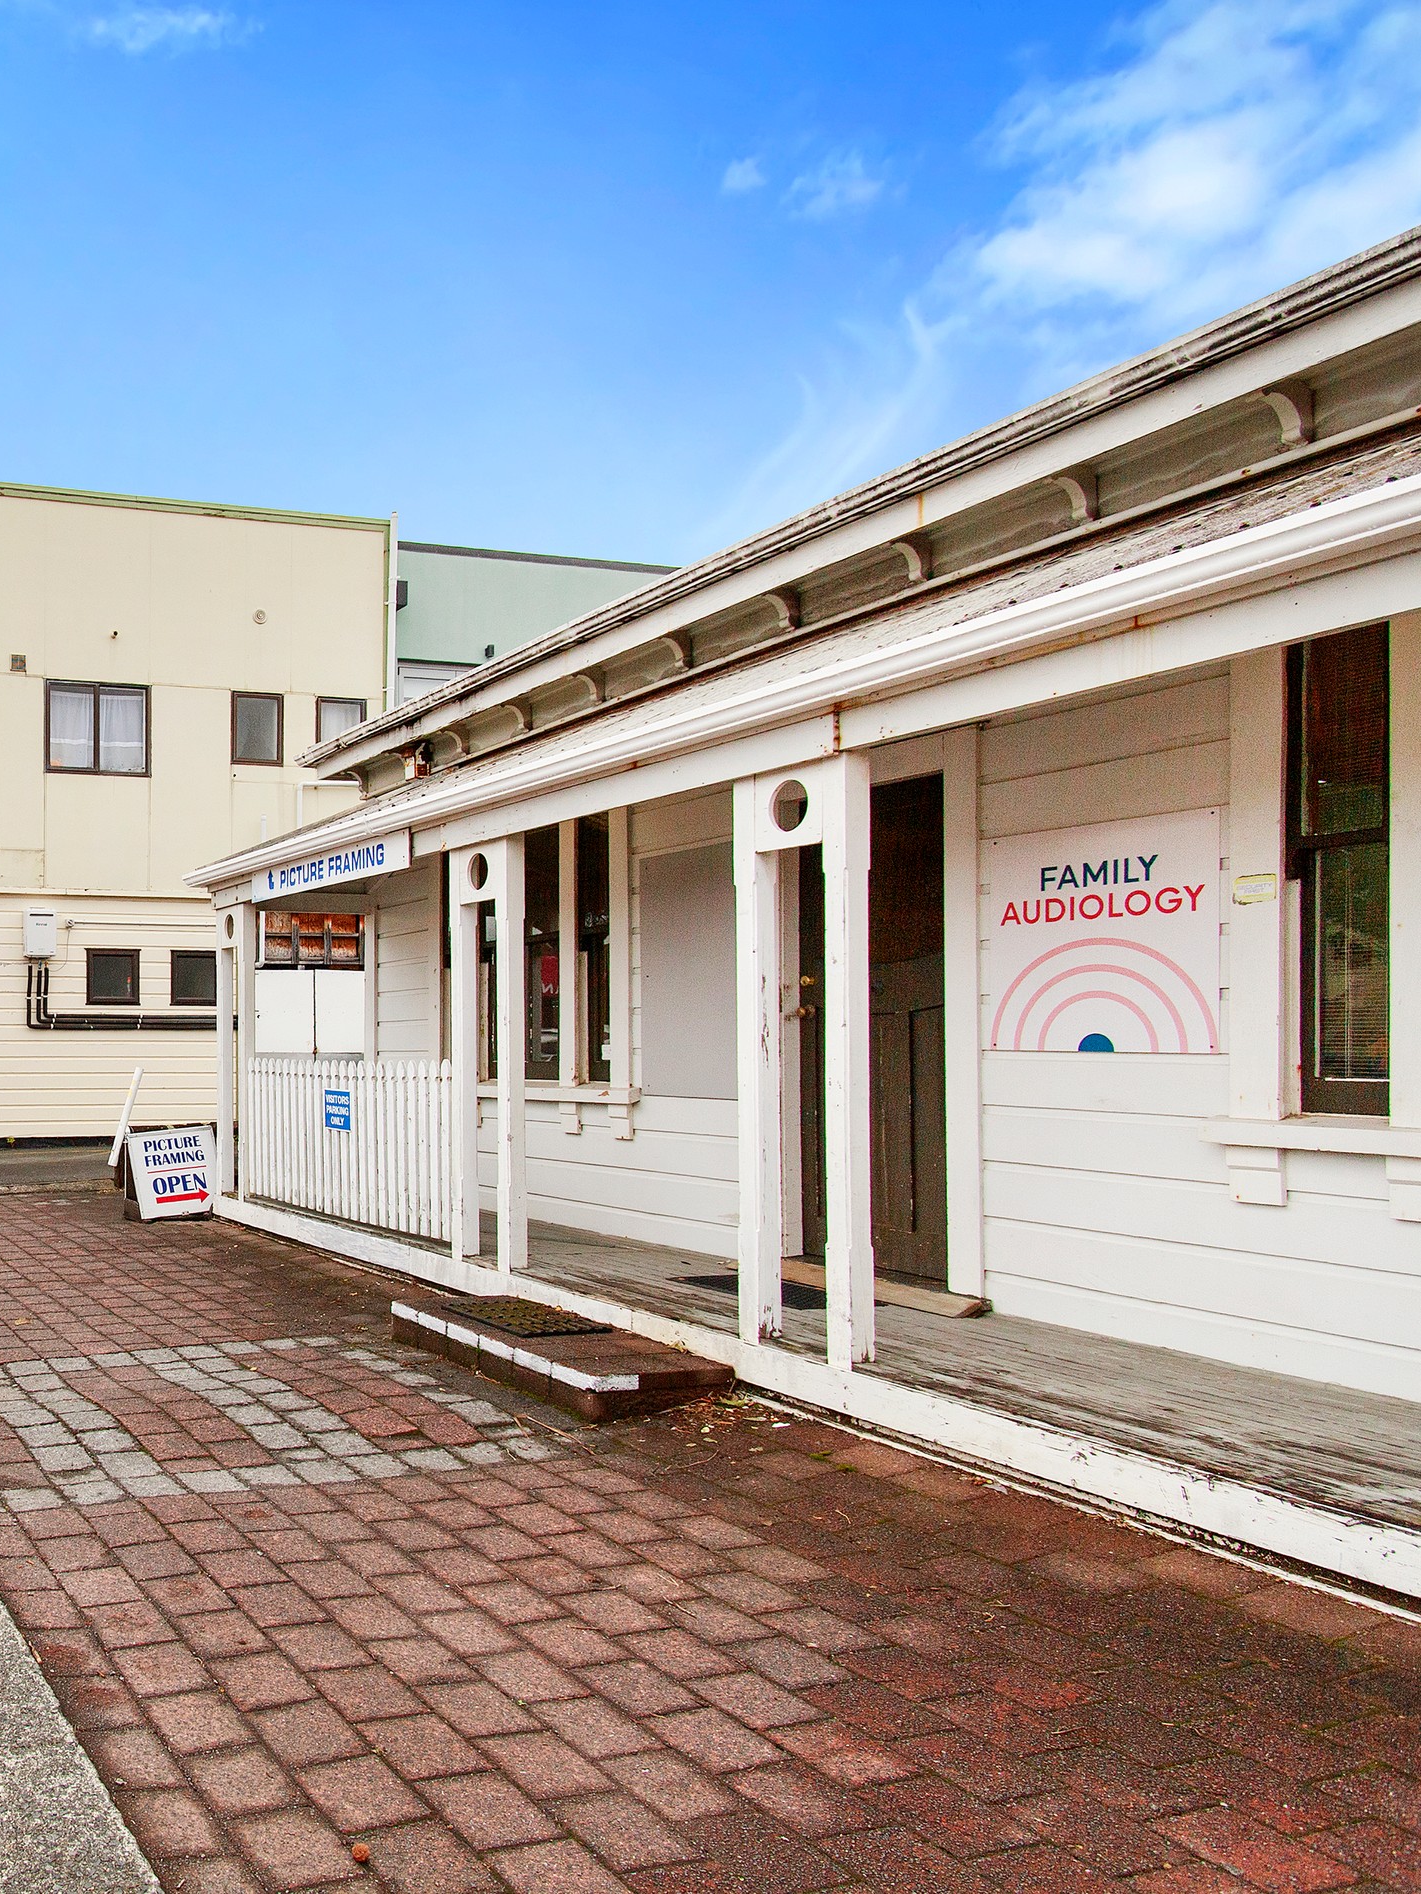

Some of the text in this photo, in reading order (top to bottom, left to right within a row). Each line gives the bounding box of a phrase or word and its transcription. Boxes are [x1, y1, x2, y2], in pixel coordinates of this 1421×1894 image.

[280, 843, 385, 889] PICTURE FRAMING
[1040, 854, 1159, 892] FAMILY
[1000, 884, 1206, 926] AUDIOLOGY
[326, 1094, 349, 1105] VISITORS
[326, 1105, 348, 1116] PARKING
[330, 1116, 344, 1126] ONLY
[143, 1135, 202, 1152] PICTURE
[144, 1149, 205, 1167] FRAMING
[152, 1172, 208, 1195] OPEN
